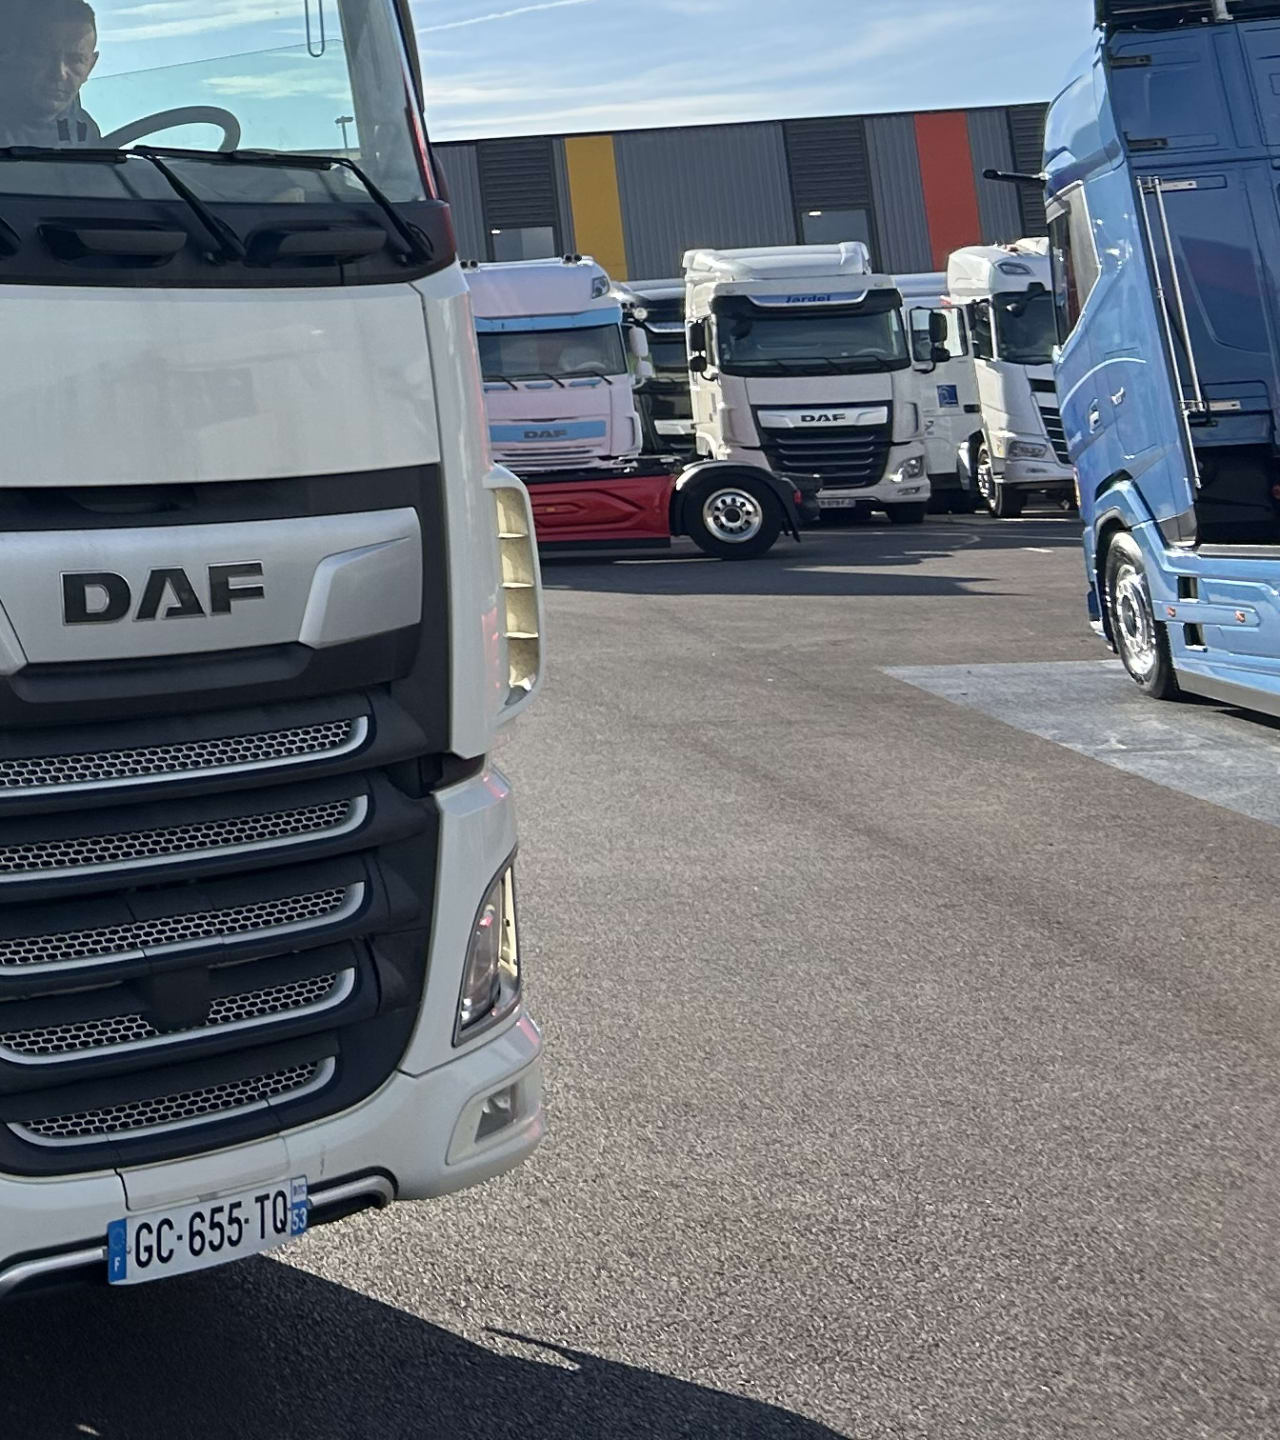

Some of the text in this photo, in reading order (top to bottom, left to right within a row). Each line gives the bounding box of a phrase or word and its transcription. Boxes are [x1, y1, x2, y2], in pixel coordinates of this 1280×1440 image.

[800, 413, 846, 423] DAF
[523, 429, 568, 440] DAF
[60, 559, 265, 626] DAF
[292, 1207, 307, 1230] 53
[135, 1190, 288, 1268] GC-655-TQ
[114, 1256, 121, 1272] F
